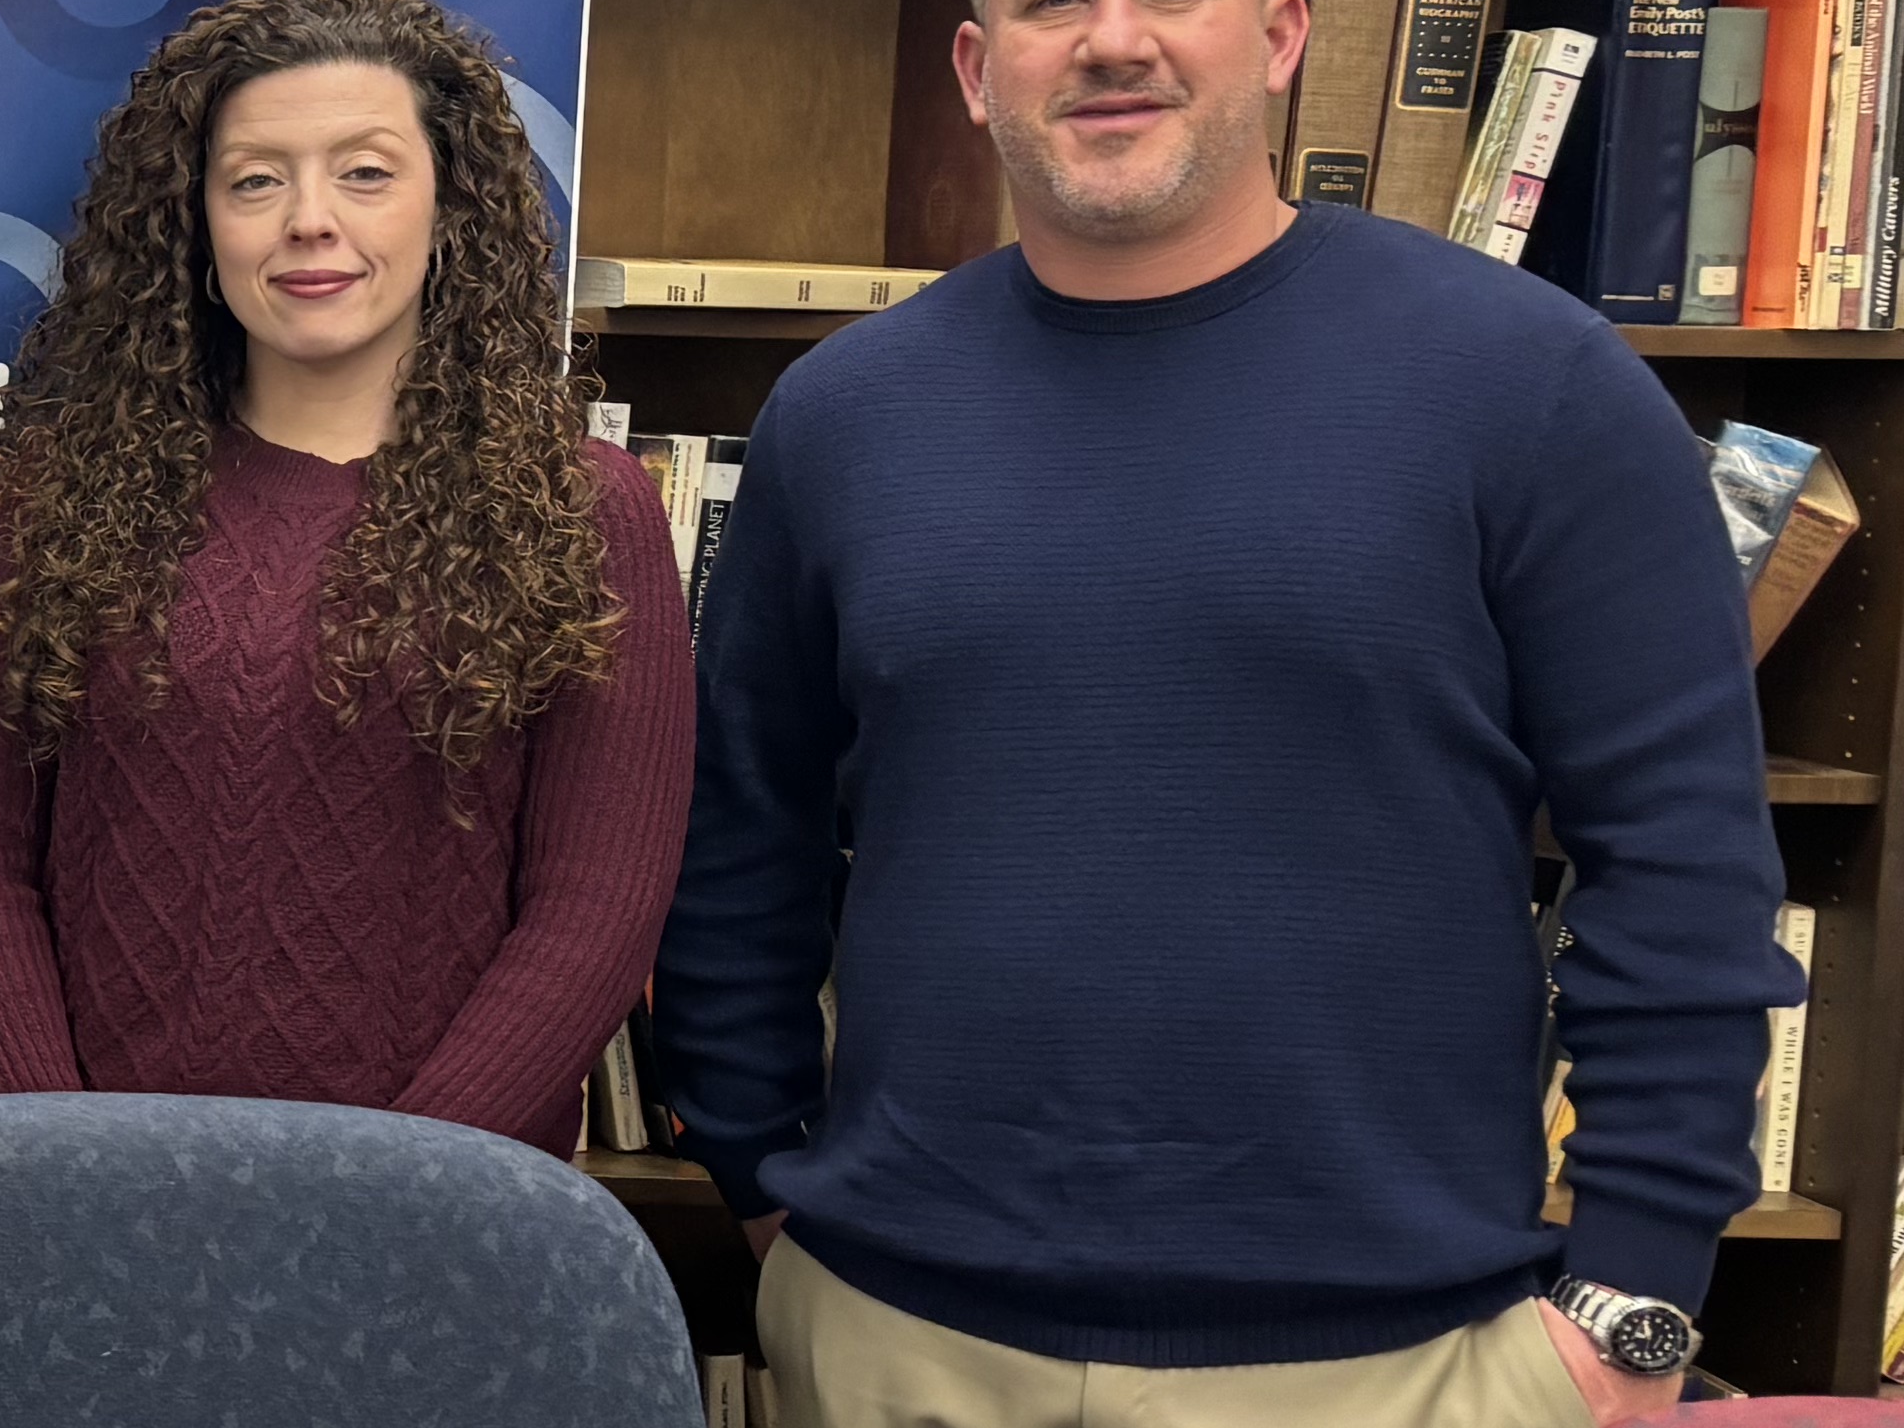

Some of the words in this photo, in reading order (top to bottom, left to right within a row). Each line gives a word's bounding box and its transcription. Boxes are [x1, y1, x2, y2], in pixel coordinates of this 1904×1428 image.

[1629, 5, 1666, 22] Emily
[1667, 6, 1705, 22] Post's
[1882, 176, 1900, 242] Careers
[1875, 243, 1897, 317] Military
[702, 499, 726, 561] PLANET
[1782, 1024, 1798, 1073] WHILE
[1778, 1091, 1792, 1122] WAS
[1774, 1127, 1788, 1168] GONE
